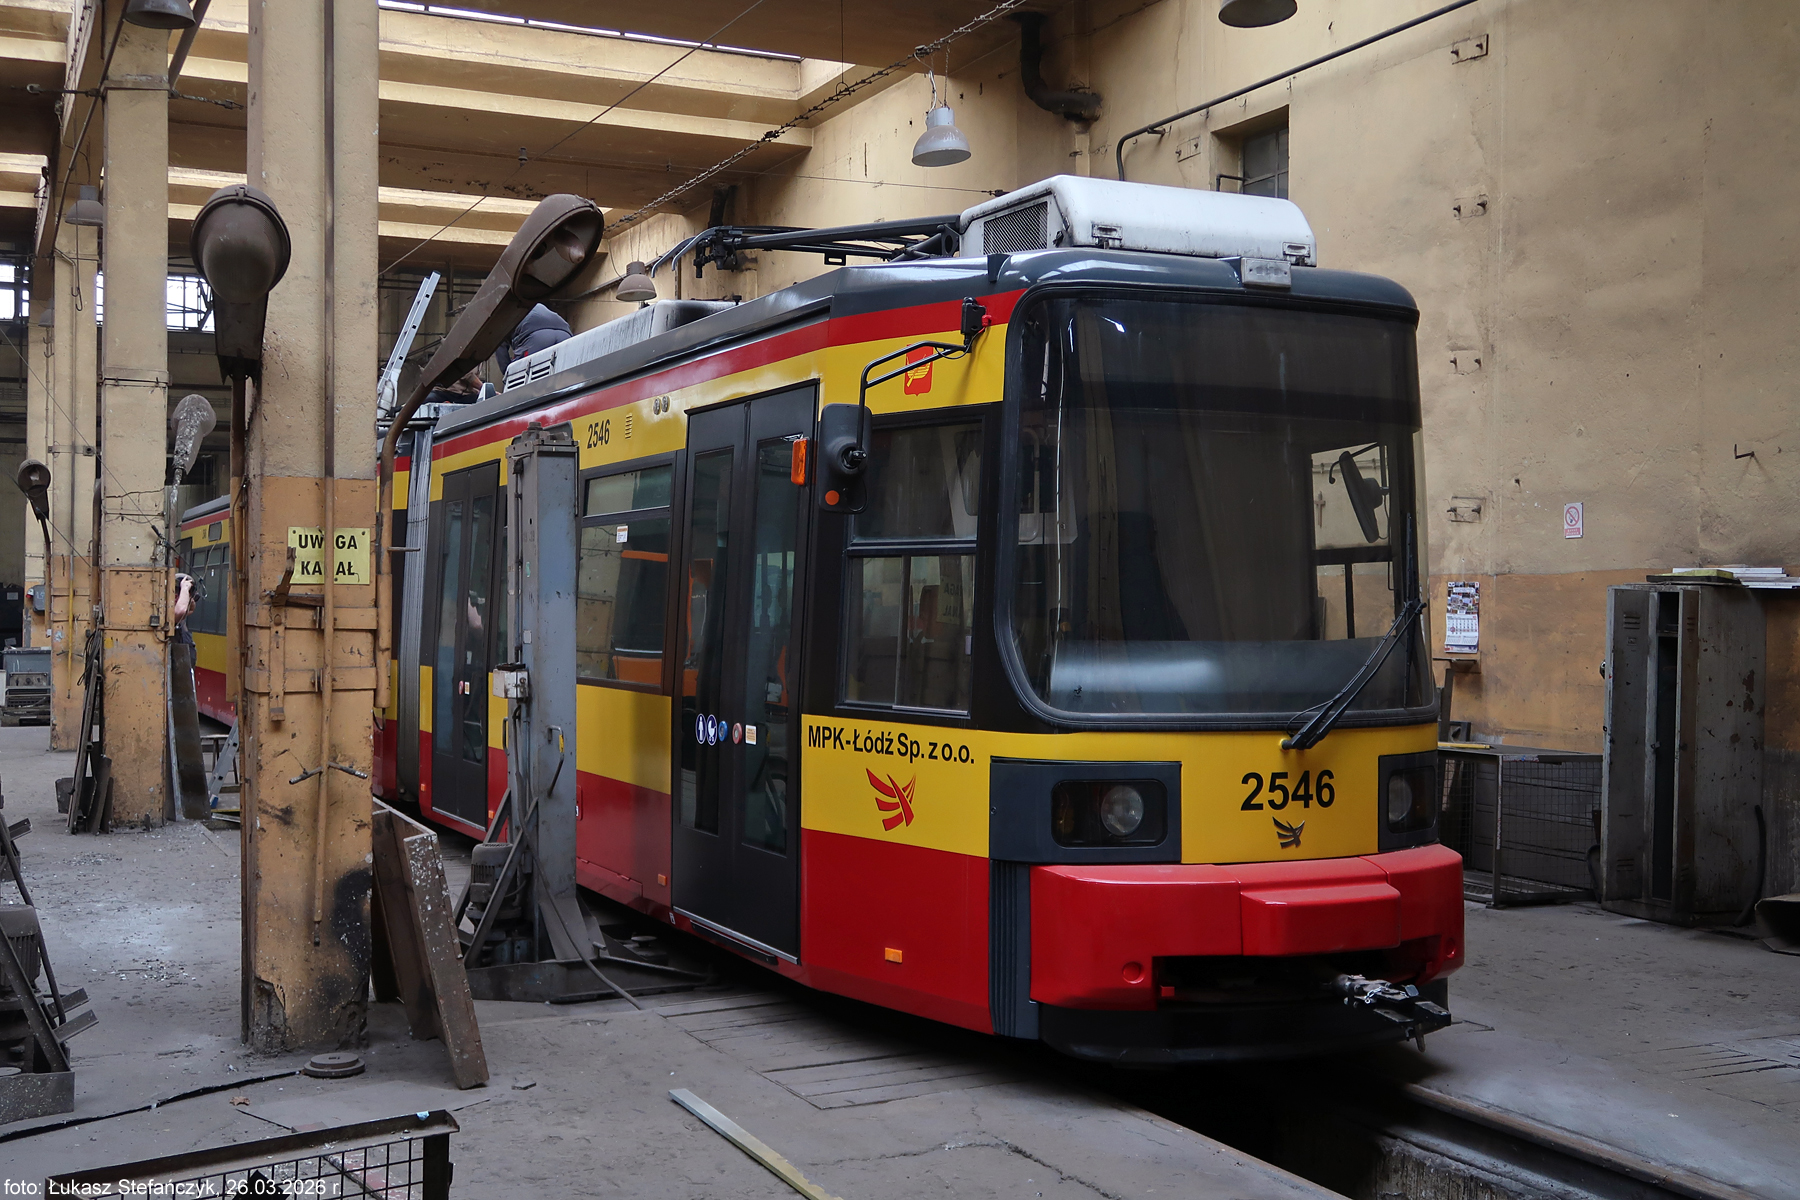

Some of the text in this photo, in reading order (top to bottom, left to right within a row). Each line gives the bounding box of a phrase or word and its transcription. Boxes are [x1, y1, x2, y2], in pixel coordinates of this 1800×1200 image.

[587, 419, 610, 449] 2546
[298, 534, 358, 549] UWGA
[301, 561, 355, 576] KAAŁ
[808, 725, 975, 764] MPK-Łódź Sp. z o.o.
[1240, 769, 1335, 811] 2546
